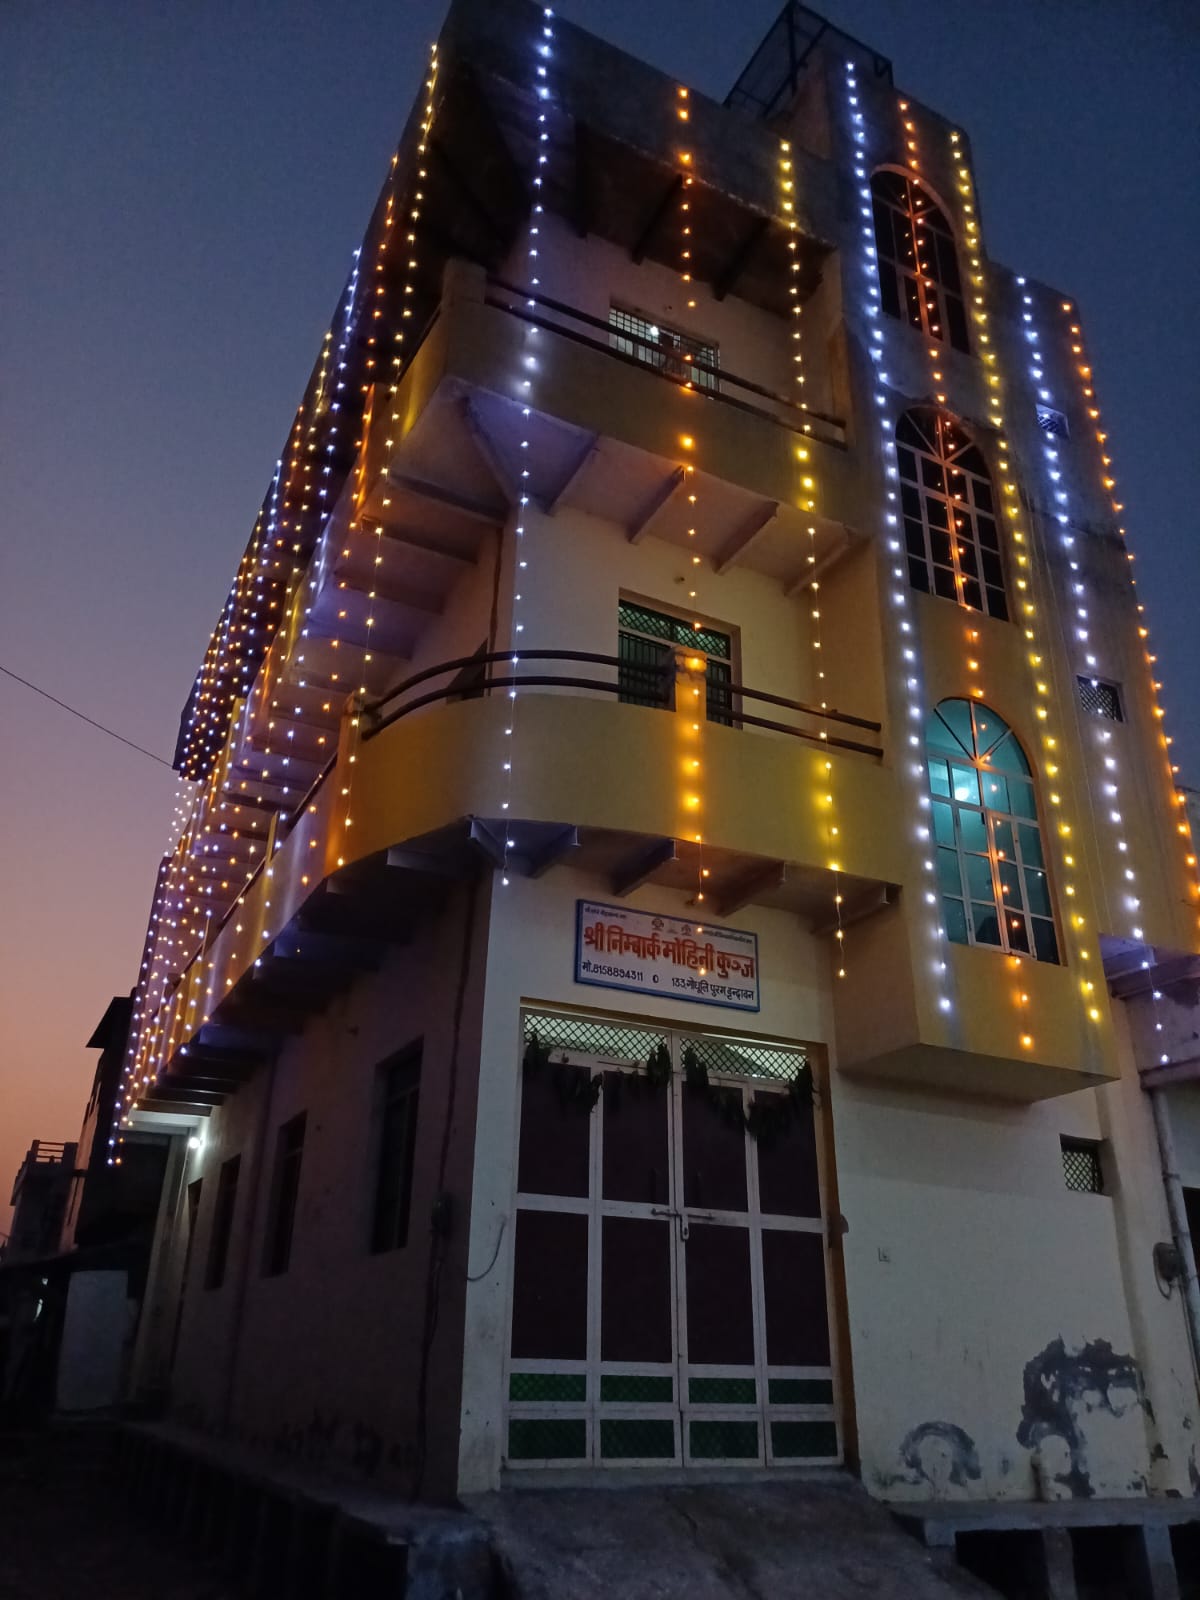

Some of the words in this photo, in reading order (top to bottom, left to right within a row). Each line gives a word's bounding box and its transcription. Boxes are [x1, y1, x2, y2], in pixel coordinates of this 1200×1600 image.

[584, 922, 604, 952] श्री
[607, 925, 661, 960] निम्बार्क
[662, 937, 714, 971] मोहिनी
